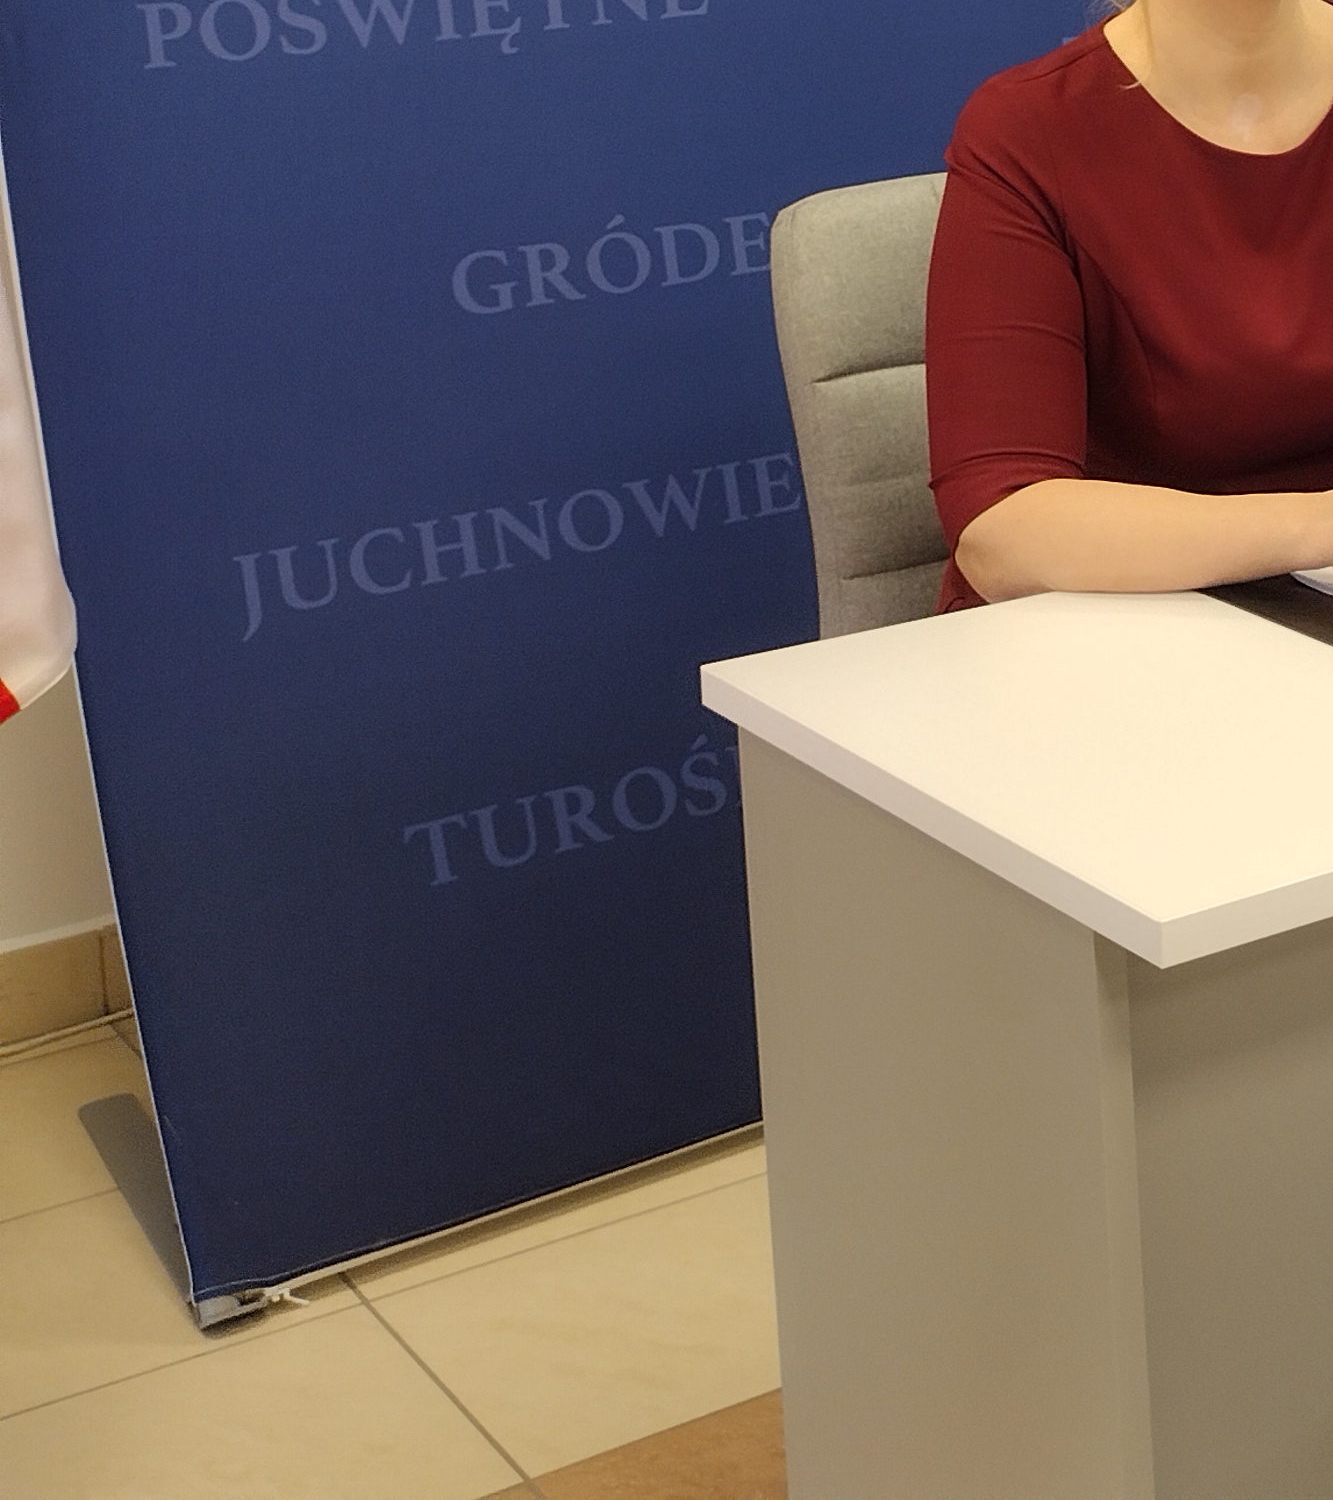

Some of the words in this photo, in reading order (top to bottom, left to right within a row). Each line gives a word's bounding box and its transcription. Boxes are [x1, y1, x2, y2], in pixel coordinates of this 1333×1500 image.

[452, 211, 771, 314] GRÓDE
[233, 451, 801, 642] JUCHNOWIE
[402, 734, 741, 887] TUROŚ
